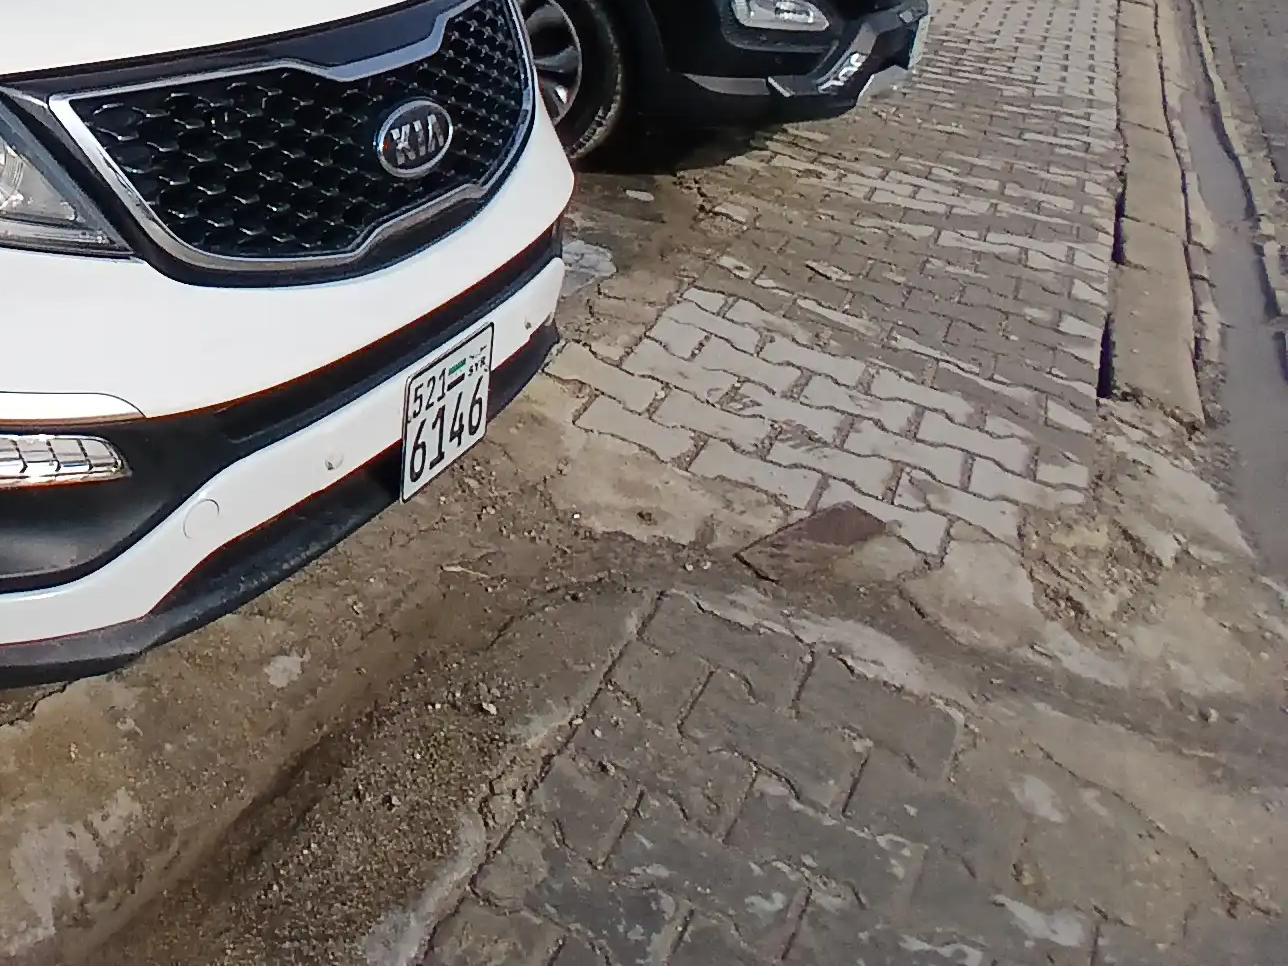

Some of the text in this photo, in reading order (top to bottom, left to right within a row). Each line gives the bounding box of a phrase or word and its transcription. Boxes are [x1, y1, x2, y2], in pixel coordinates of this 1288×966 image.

[390, 114, 445, 165] KIA
[412, 367, 447, 419] 521
[409, 374, 484, 483] 6146
